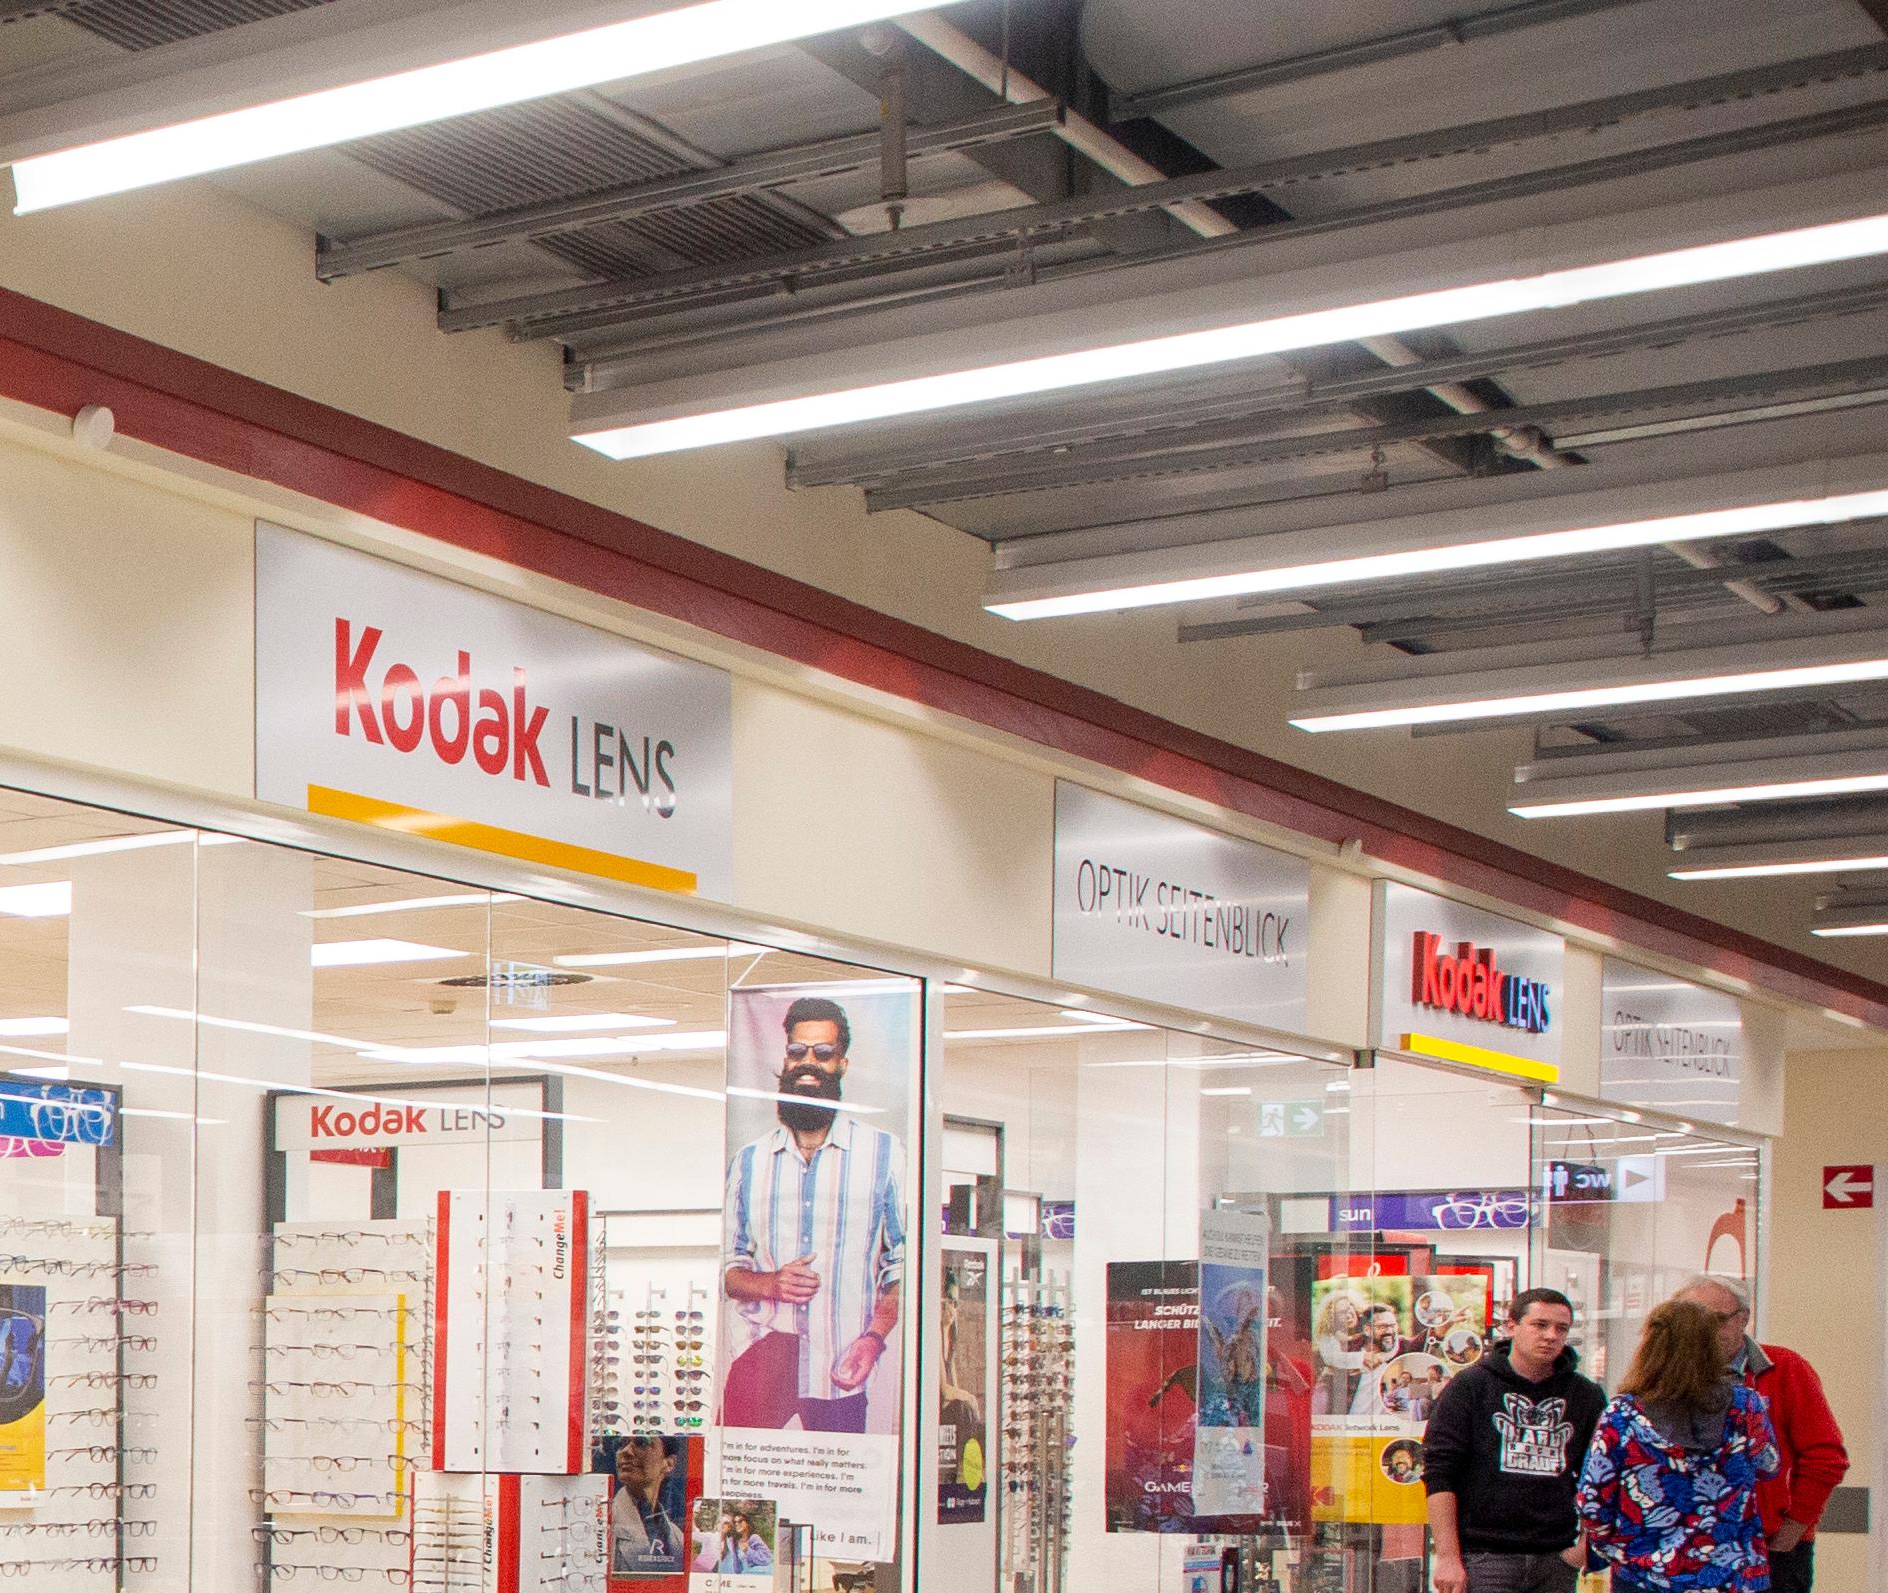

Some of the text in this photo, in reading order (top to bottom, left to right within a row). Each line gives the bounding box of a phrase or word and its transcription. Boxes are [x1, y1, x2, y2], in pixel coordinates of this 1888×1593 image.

[335, 617, 676, 819] Kodak LENS
[1078, 859, 1290, 967] OPTIK SEITENBLICK
[1411, 931, 1551, 1034] Kodak LENS
[310, 1102, 506, 1138] Kodak LENS
[1339, 1206, 1371, 1222] sun
[553, 1209, 569, 1280] ChangeMe!
[745, 1443, 757, 1451] for
[744, 1454, 768, 1463] focus
[784, 1457, 804, 1465] what
[807, 1459, 829, 1469] really
[758, 1468, 780, 1476] more
[730, 1478, 741, 1486] for
[824, 1484, 837, 1492] for
[840, 1486, 862, 1494] more
[848, 1534, 871, 1545] am.
